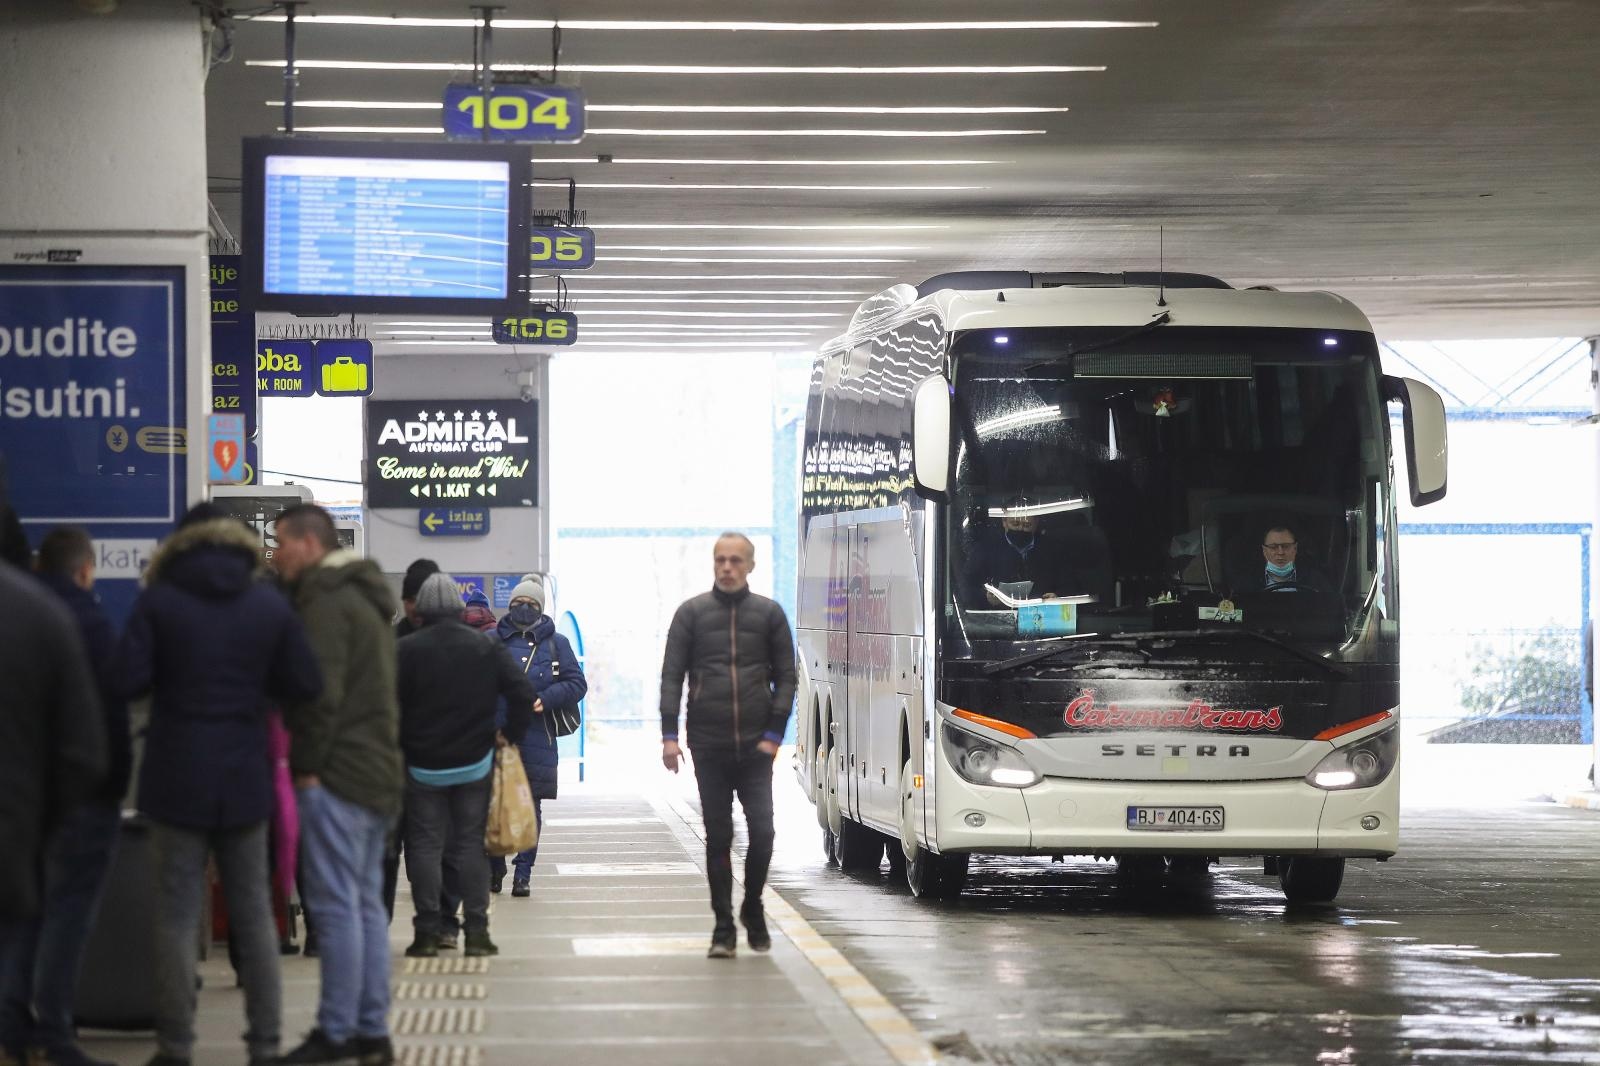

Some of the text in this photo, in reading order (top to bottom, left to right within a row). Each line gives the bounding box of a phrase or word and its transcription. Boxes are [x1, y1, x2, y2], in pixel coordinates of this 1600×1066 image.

[458, 96, 570, 130] 104
[530, 237, 583, 261] 05
[502, 319, 568, 339] 106
[211, 363, 239, 376] ca
[274, 378, 302, 391] ROOM
[0, 378, 140, 418] sutni.
[211, 396, 240, 409] az
[378, 418, 529, 445] ADMIRAL
[409, 442, 503, 452] AUTOMAT CLUB
[377, 456, 529, 479] Come in and Win!
[435, 484, 471, 498] 1.KAT
[449, 510, 483, 522] izlaz
[1101, 744, 1250, 757] SETRA
[1138, 810, 1157, 825] BJ
[1167, 810, 1221, 825] 404-GS
